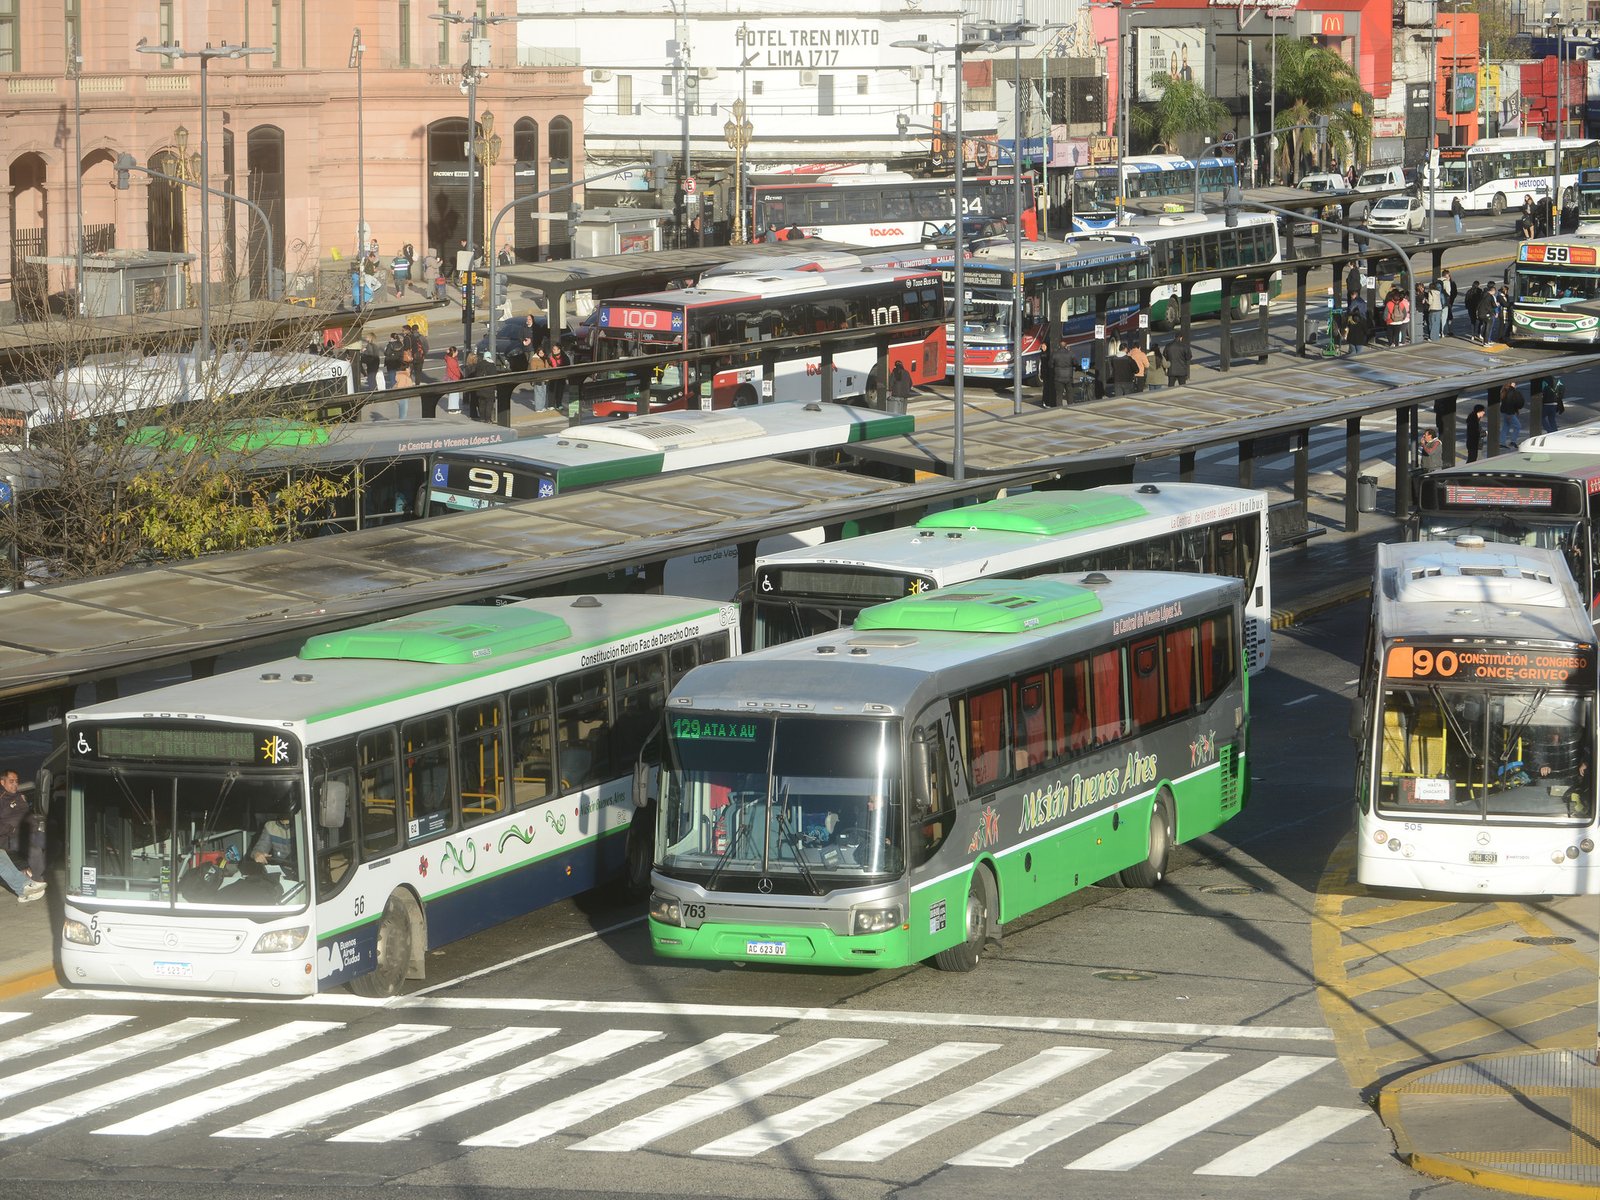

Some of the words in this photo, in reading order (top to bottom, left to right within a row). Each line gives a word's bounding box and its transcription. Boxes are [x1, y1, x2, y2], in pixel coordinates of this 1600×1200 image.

[735, 29, 787, 46] HOTEL
[790, 29, 831, 46] TREN
[835, 29, 879, 46] MIXTO
[767, 50, 804, 66] LIMA
[808, 50, 839, 66] 1717
[1546, 247, 1568, 261] 59
[623, 310, 657, 328] 100
[871, 305, 901, 326] 100
[331, 366, 343, 377] 90
[407, 441, 432, 451] Central
[433, 439, 442, 449] de
[443, 438, 469, 448] Vicente
[468, 467, 514, 497] 91
[693, 554, 711, 564] Lope
[712, 551, 722, 560] de
[723, 549, 738, 559] Veg
[718, 605, 736, 627] 62
[1119, 613, 1137, 633] Central
[1143, 607, 1161, 626] Vicente
[580, 645, 620, 667] Constitución
[620, 640, 639, 656] Retiro
[639, 638, 651, 651] Fac
[651, 634, 659, 647] de
[659, 629, 684, 645] Derecho
[684, 625, 700, 637] Once
[1413, 649, 1459, 677] 90
[1458, 652, 1528, 666] CONSTITUCIÓN
[1535, 655, 1587, 669] CONGRESO
[1475, 666, 1569, 681] ONCE-GRIVEO
[673, 718, 701, 738] 129
[729, 723, 737, 736] X
[1018, 780, 1069, 834] Misión
[1070, 768, 1120, 812] Buenos
[1121, 751, 1158, 794] Aires
[354, 894, 365, 917] 56
[683, 903, 706, 919] 763
[340, 938, 357, 951] Buenos
[342, 947, 356, 958] Aires
[748, 944, 758, 953] AC
[759, 944, 773, 954] 623
[344, 952, 361, 967] Ciudad
